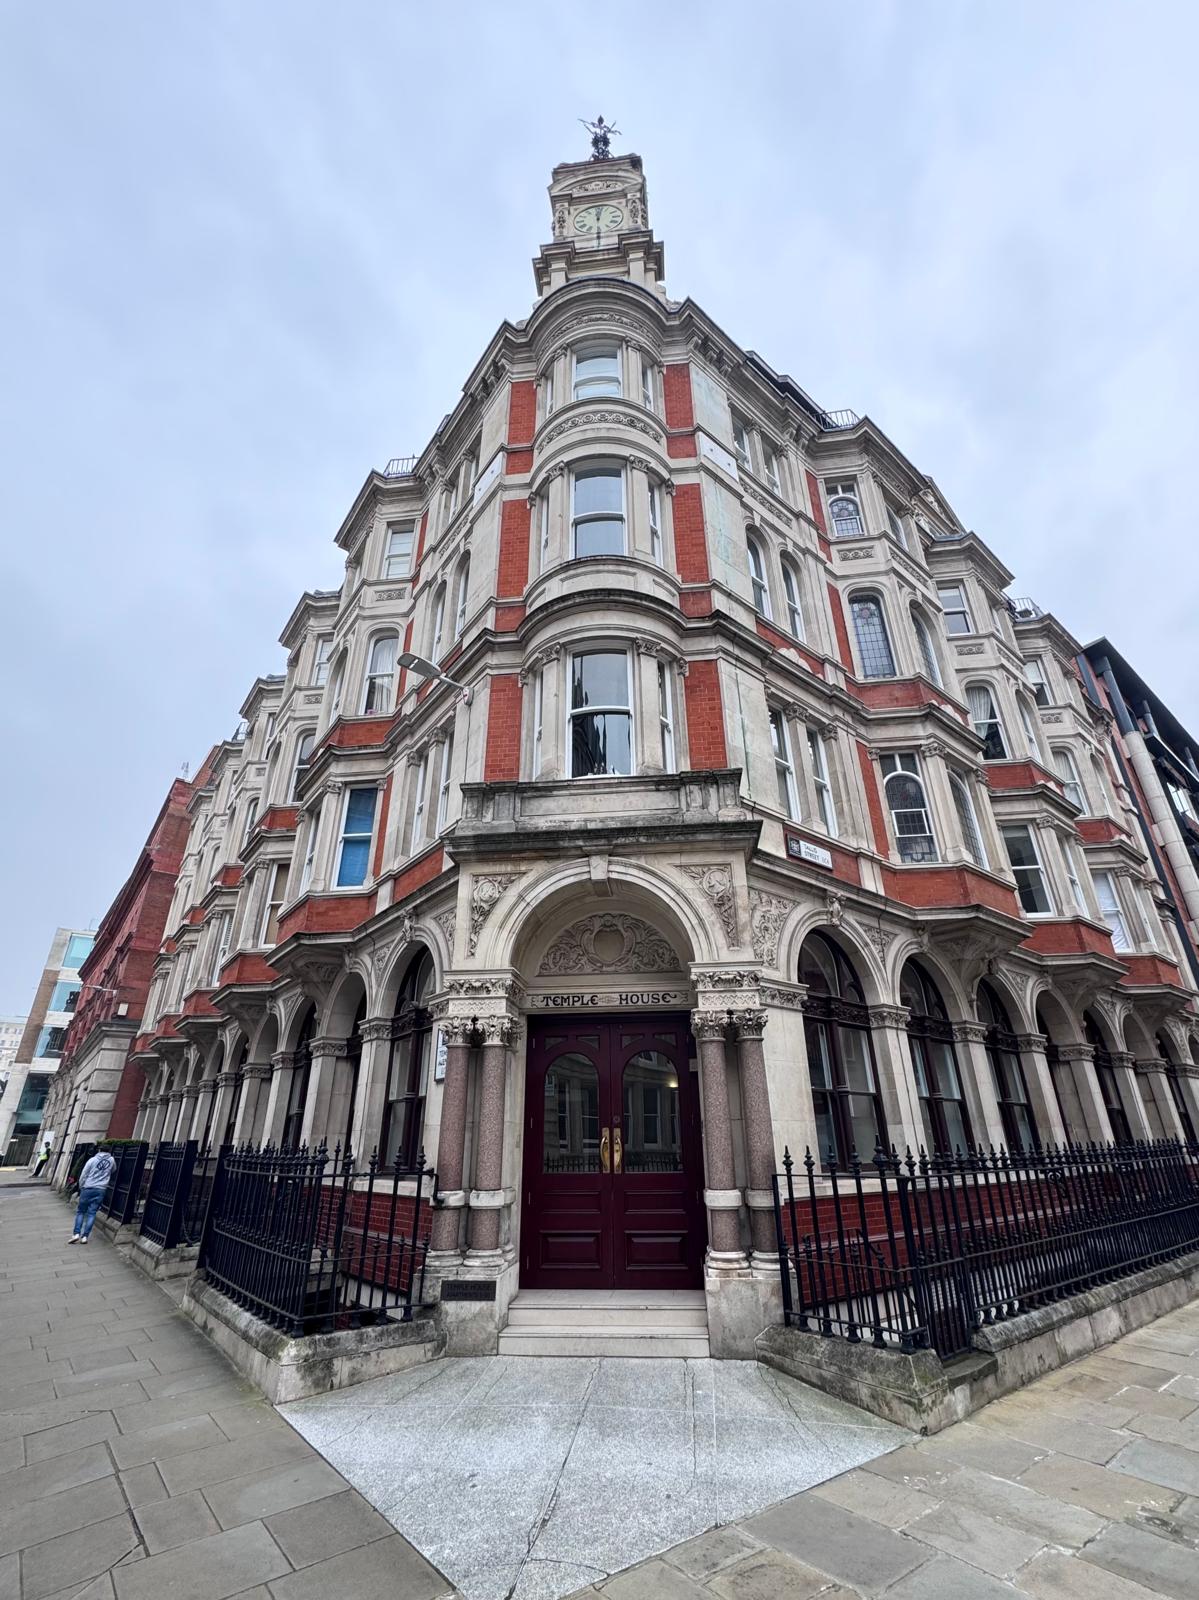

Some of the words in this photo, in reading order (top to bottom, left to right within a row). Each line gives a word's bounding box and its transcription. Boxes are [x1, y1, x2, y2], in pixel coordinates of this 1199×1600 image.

[804, 843, 818, 854] TALLIS
[804, 850, 820, 861] STREET
[541, 994, 599, 1007] TEMPLE
[619, 992, 677, 1005] HOUSE
